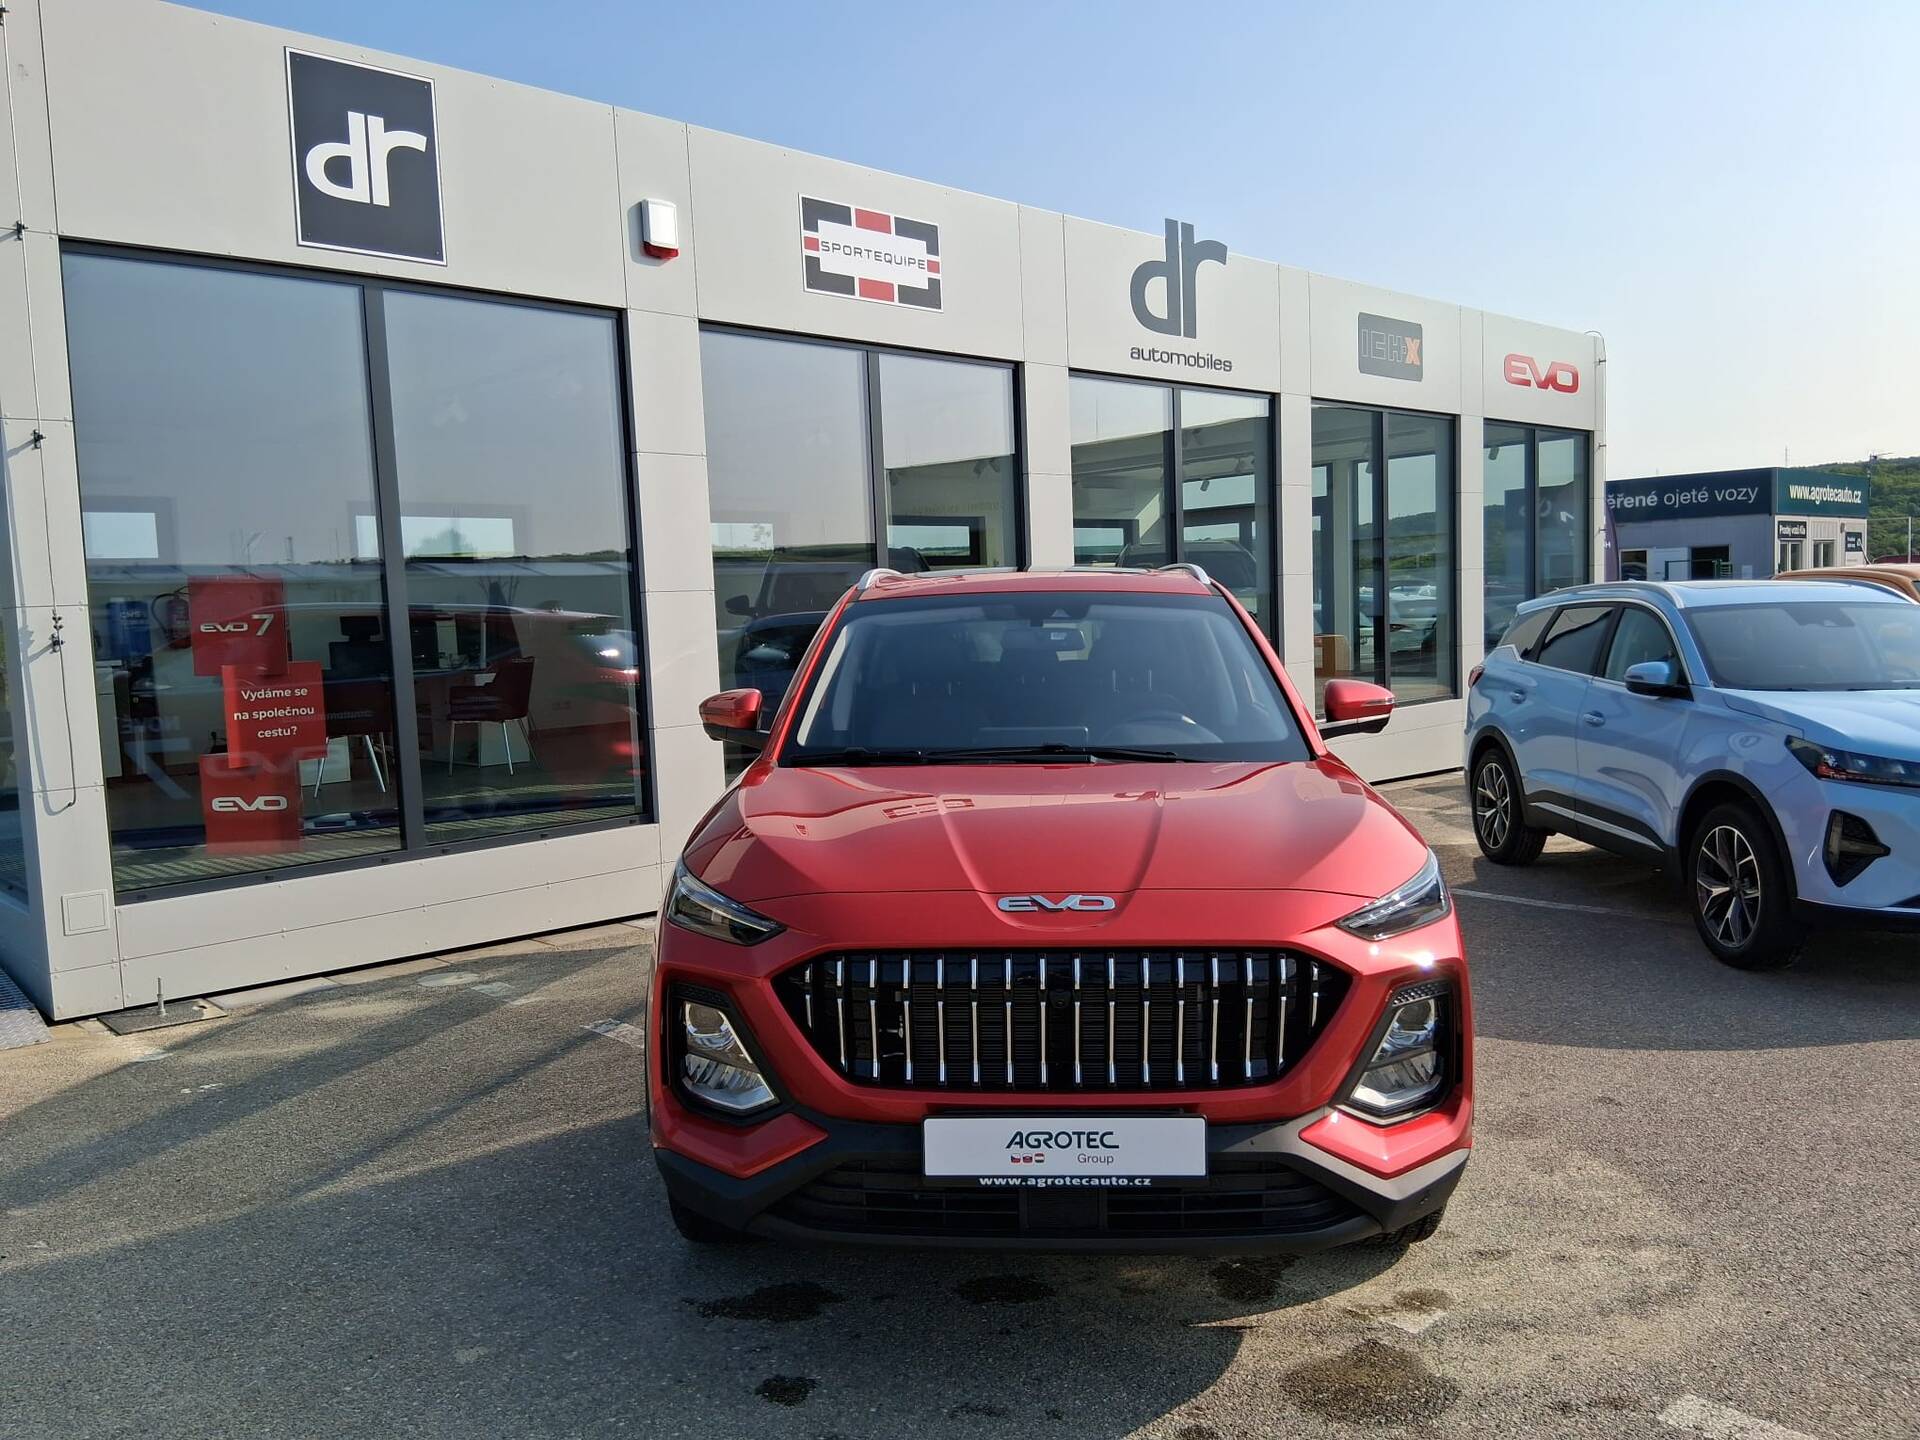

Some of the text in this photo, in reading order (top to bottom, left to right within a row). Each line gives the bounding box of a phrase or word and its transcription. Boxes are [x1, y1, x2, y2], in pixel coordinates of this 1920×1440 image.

[306, 111, 427, 207] dr
[820, 240, 926, 270] SPORTEQUIPE
[1130, 218, 1228, 339] dr
[1130, 346, 1232, 372] automobiles
[1503, 353, 1579, 394] EVO
[1663, 487, 1709, 508] ojeté
[1714, 487, 1759, 504] vozy
[1789, 484, 1862, 505] www.agrotecauto.cz
[200, 613, 275, 637] EVO 7
[241, 687, 308, 702] Vydáme se
[233, 711, 250, 721] na
[252, 706, 315, 720] společnou
[257, 726, 298, 738] cestu?
[212, 795, 288, 812] EVO
[997, 894, 1116, 912] EVO
[1006, 1131, 1120, 1149] AGROTEC
[1077, 1152, 1115, 1165] Group
[979, 1175, 1152, 1188] www.agrotecauto.cz
